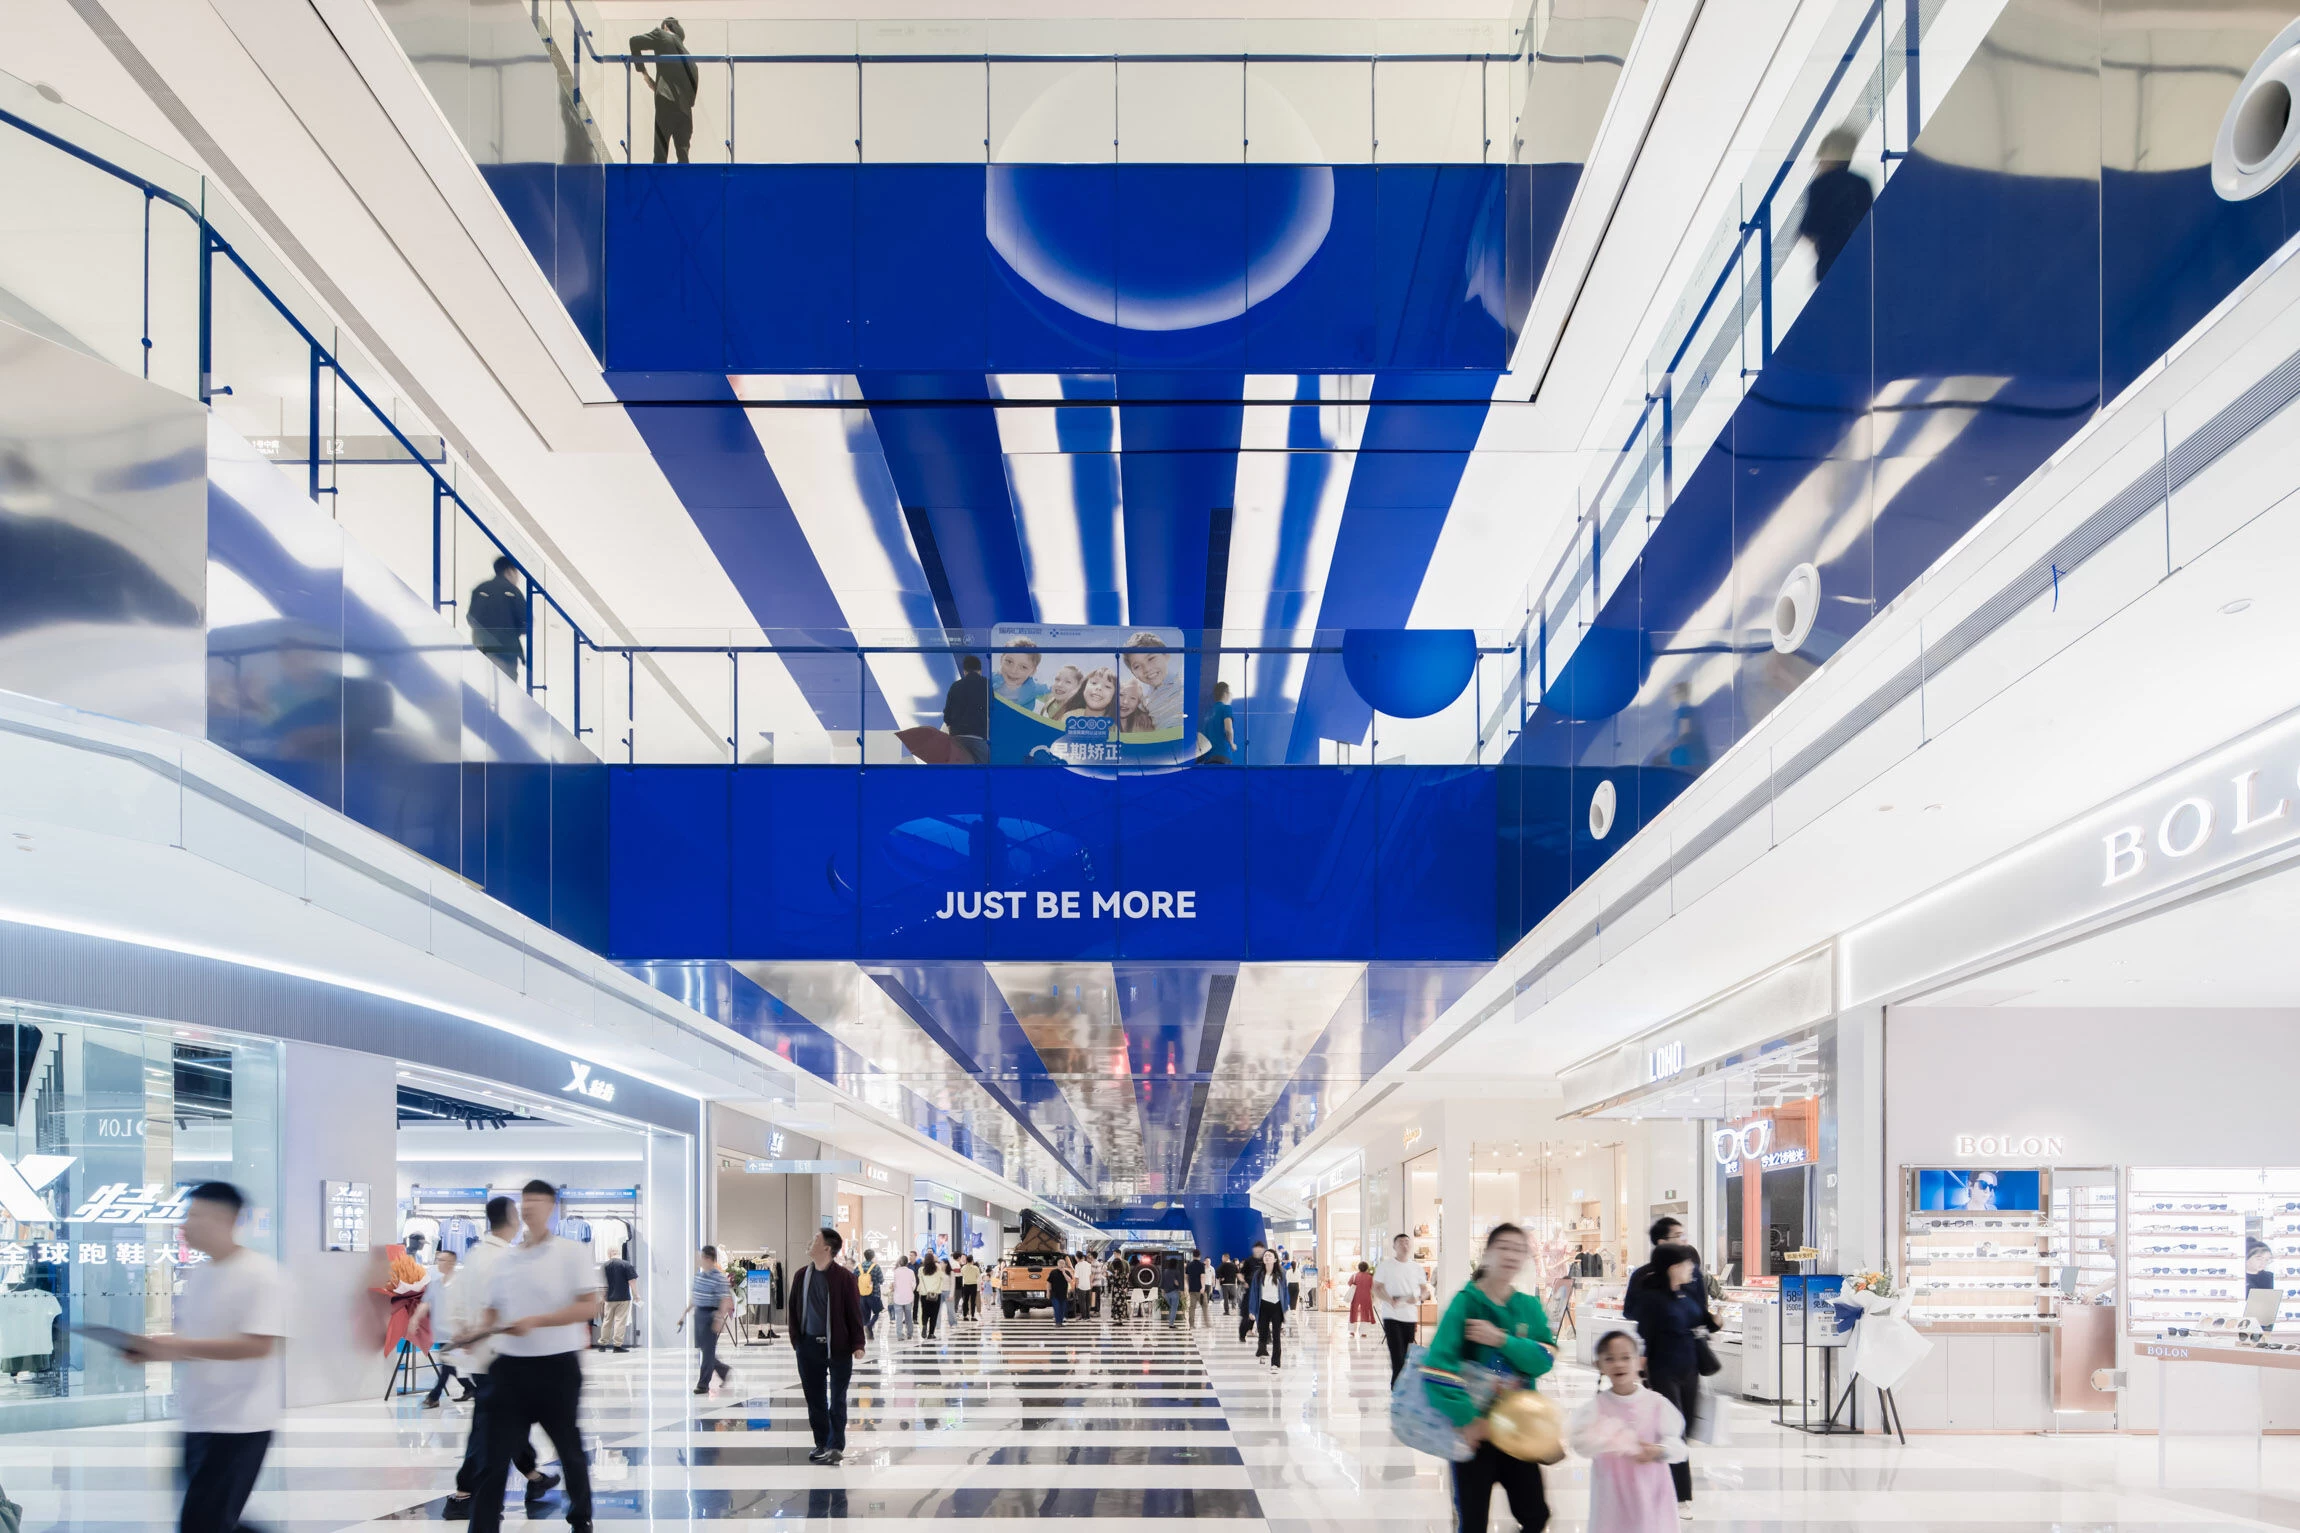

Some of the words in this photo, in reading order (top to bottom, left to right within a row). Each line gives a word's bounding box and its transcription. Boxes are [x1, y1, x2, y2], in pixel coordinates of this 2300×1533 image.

[326, 439, 345, 455] L2
[1054, 741, 1121, 761] 早期矫正
[936, 891, 1027, 919] JUST
[1036, 891, 1081, 919] BE
[1093, 891, 1197, 919] MORE
[1649, 1040, 1683, 1084] LOHO
[1958, 1136, 2065, 1156] BOLON
[2147, 1346, 2189, 1358] BOLON
